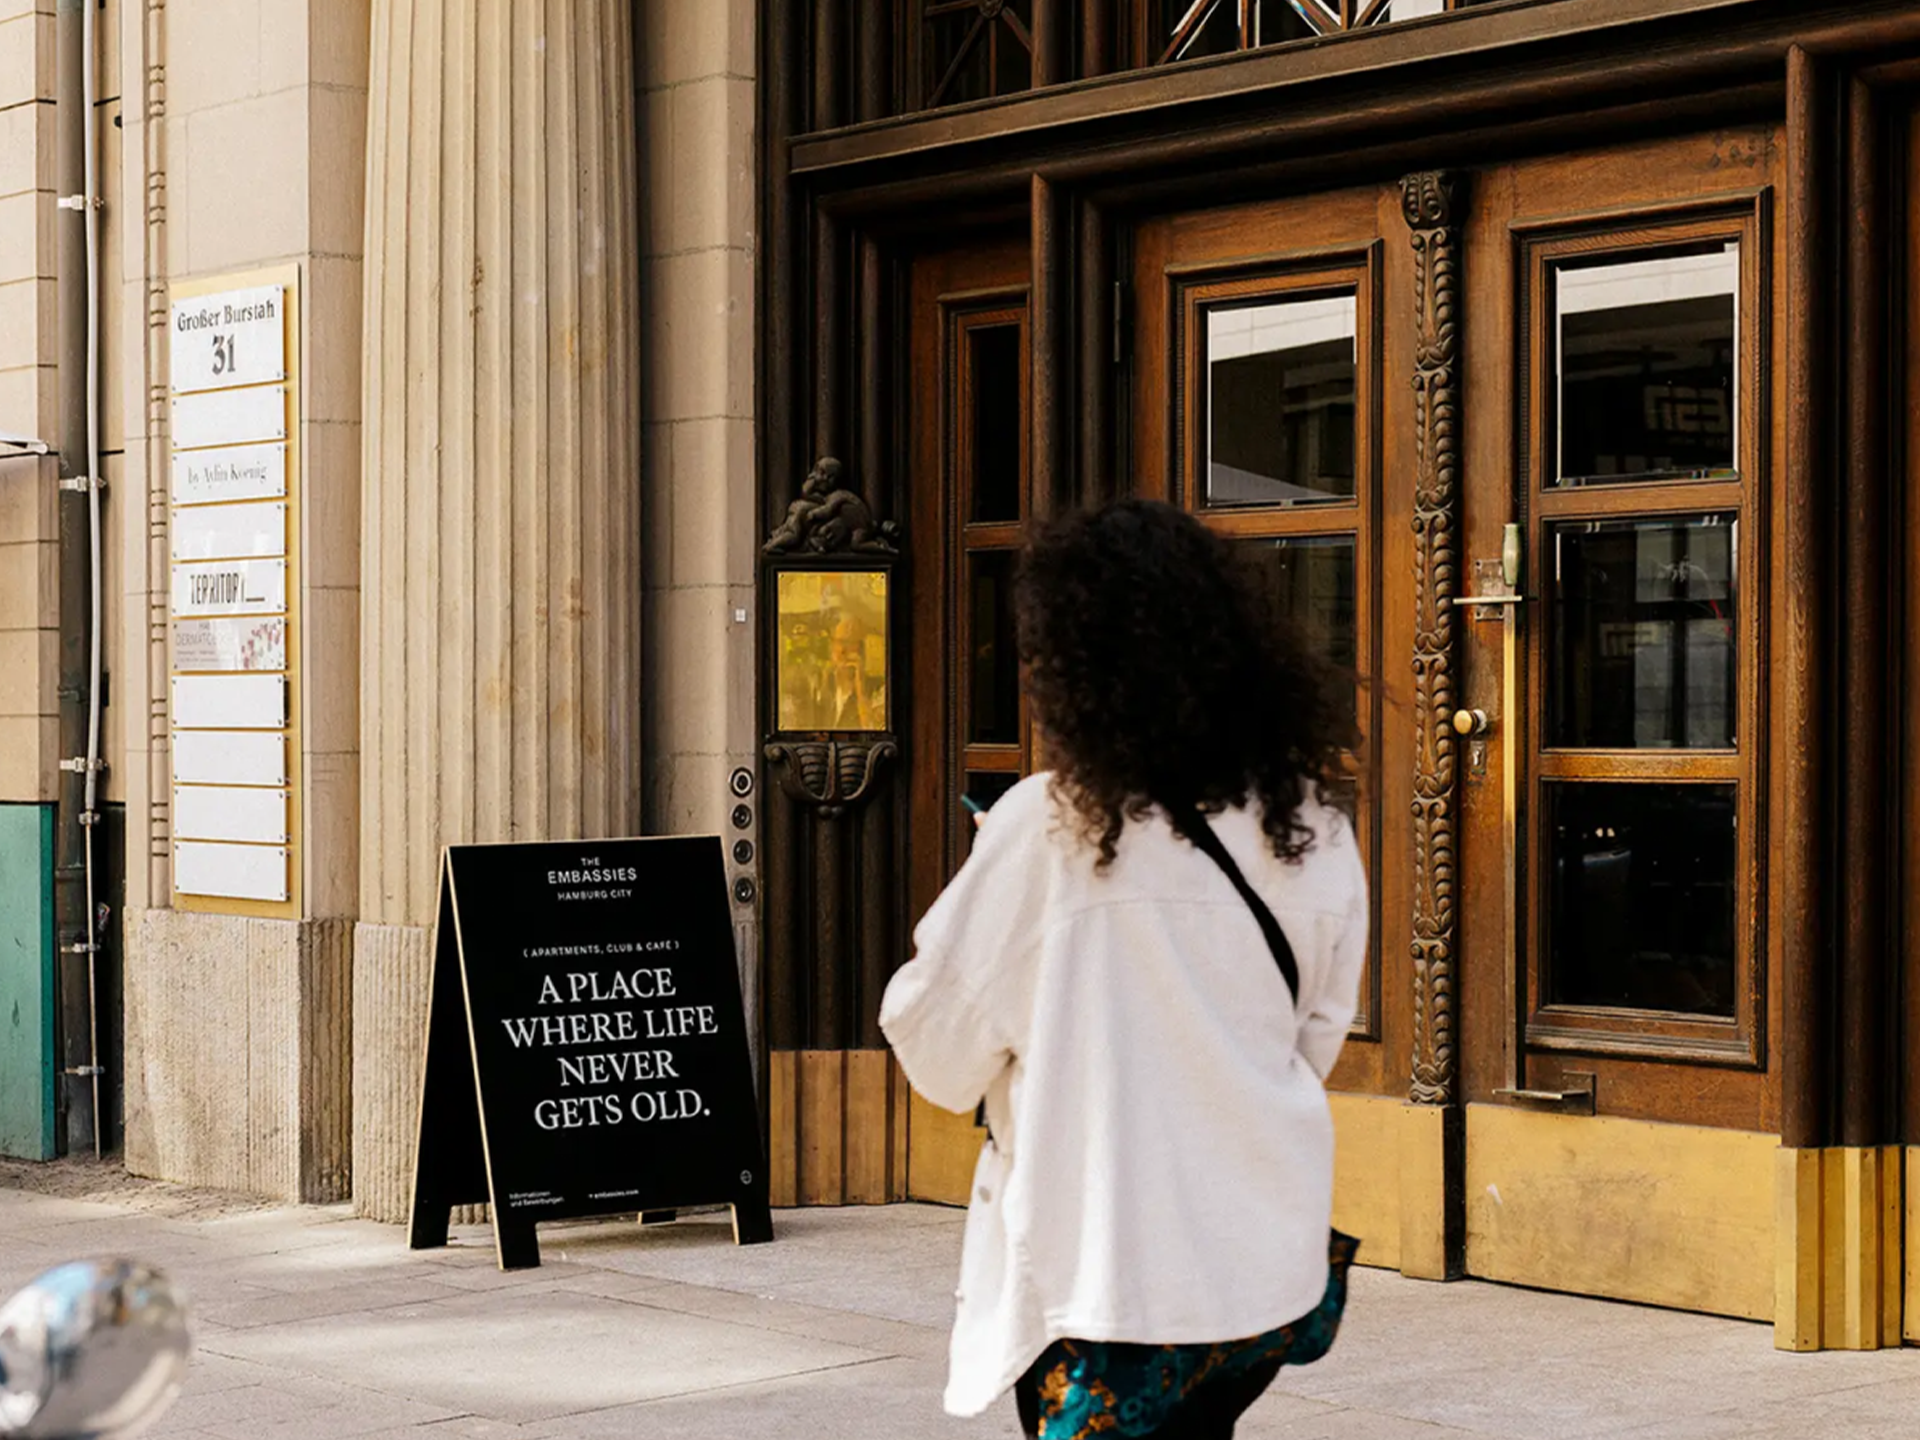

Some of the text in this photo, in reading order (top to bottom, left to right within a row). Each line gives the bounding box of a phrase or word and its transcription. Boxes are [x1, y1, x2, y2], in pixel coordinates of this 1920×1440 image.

[177, 300, 275, 332] Großer Burstah
[211, 334, 236, 376] 31
[547, 867, 638, 884] EMBASSIES
[580, 857, 600, 866] THE
[557, 888, 632, 900] HAMBURG CITY
[531, 944, 604, 957] APARTMENTS,
[606, 943, 633, 954] CLUB
[538, 968, 677, 1004] A PLACE
[501, 1005, 719, 1048] WHERE LIFE
[557, 1049, 680, 1087] NEVER
[534, 1088, 711, 1130] GETS OLD.
